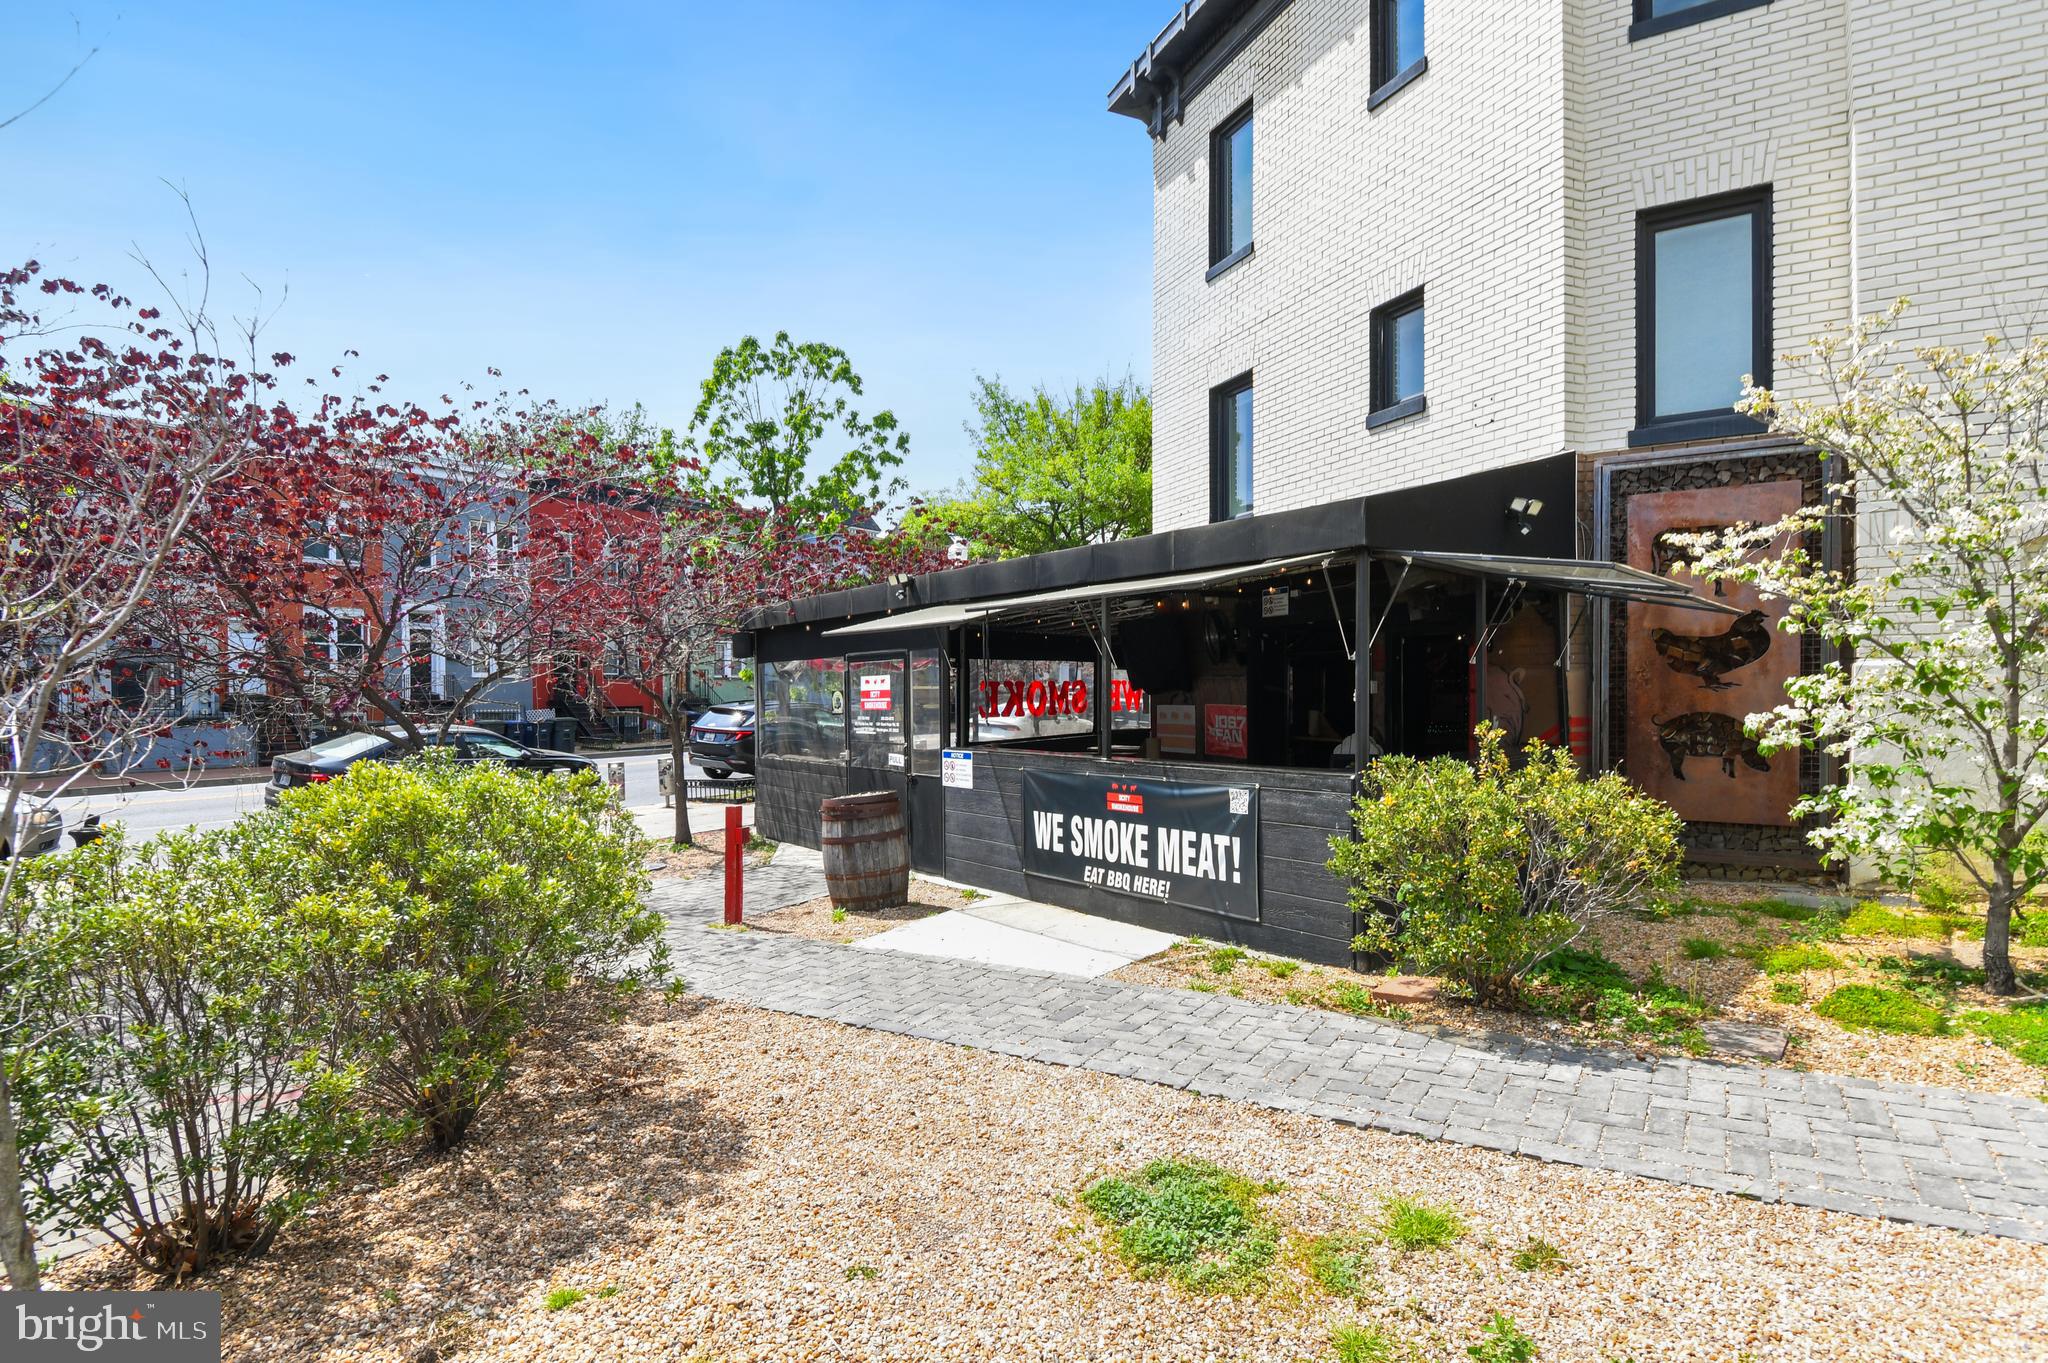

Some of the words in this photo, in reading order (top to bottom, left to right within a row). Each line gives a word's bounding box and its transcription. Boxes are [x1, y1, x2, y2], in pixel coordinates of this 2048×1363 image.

[1215, 728, 1242, 744] FAN
[889, 755, 902, 764] PULL
[1033, 811, 1064, 853] WE
[1071, 815, 1149, 868] SMOKE
[1157, 827, 1241, 884] MEAT!
[1084, 866, 1103, 883] EAT
[1107, 869, 1130, 892] BBQ
[1133, 876, 1171, 898] HERE!
